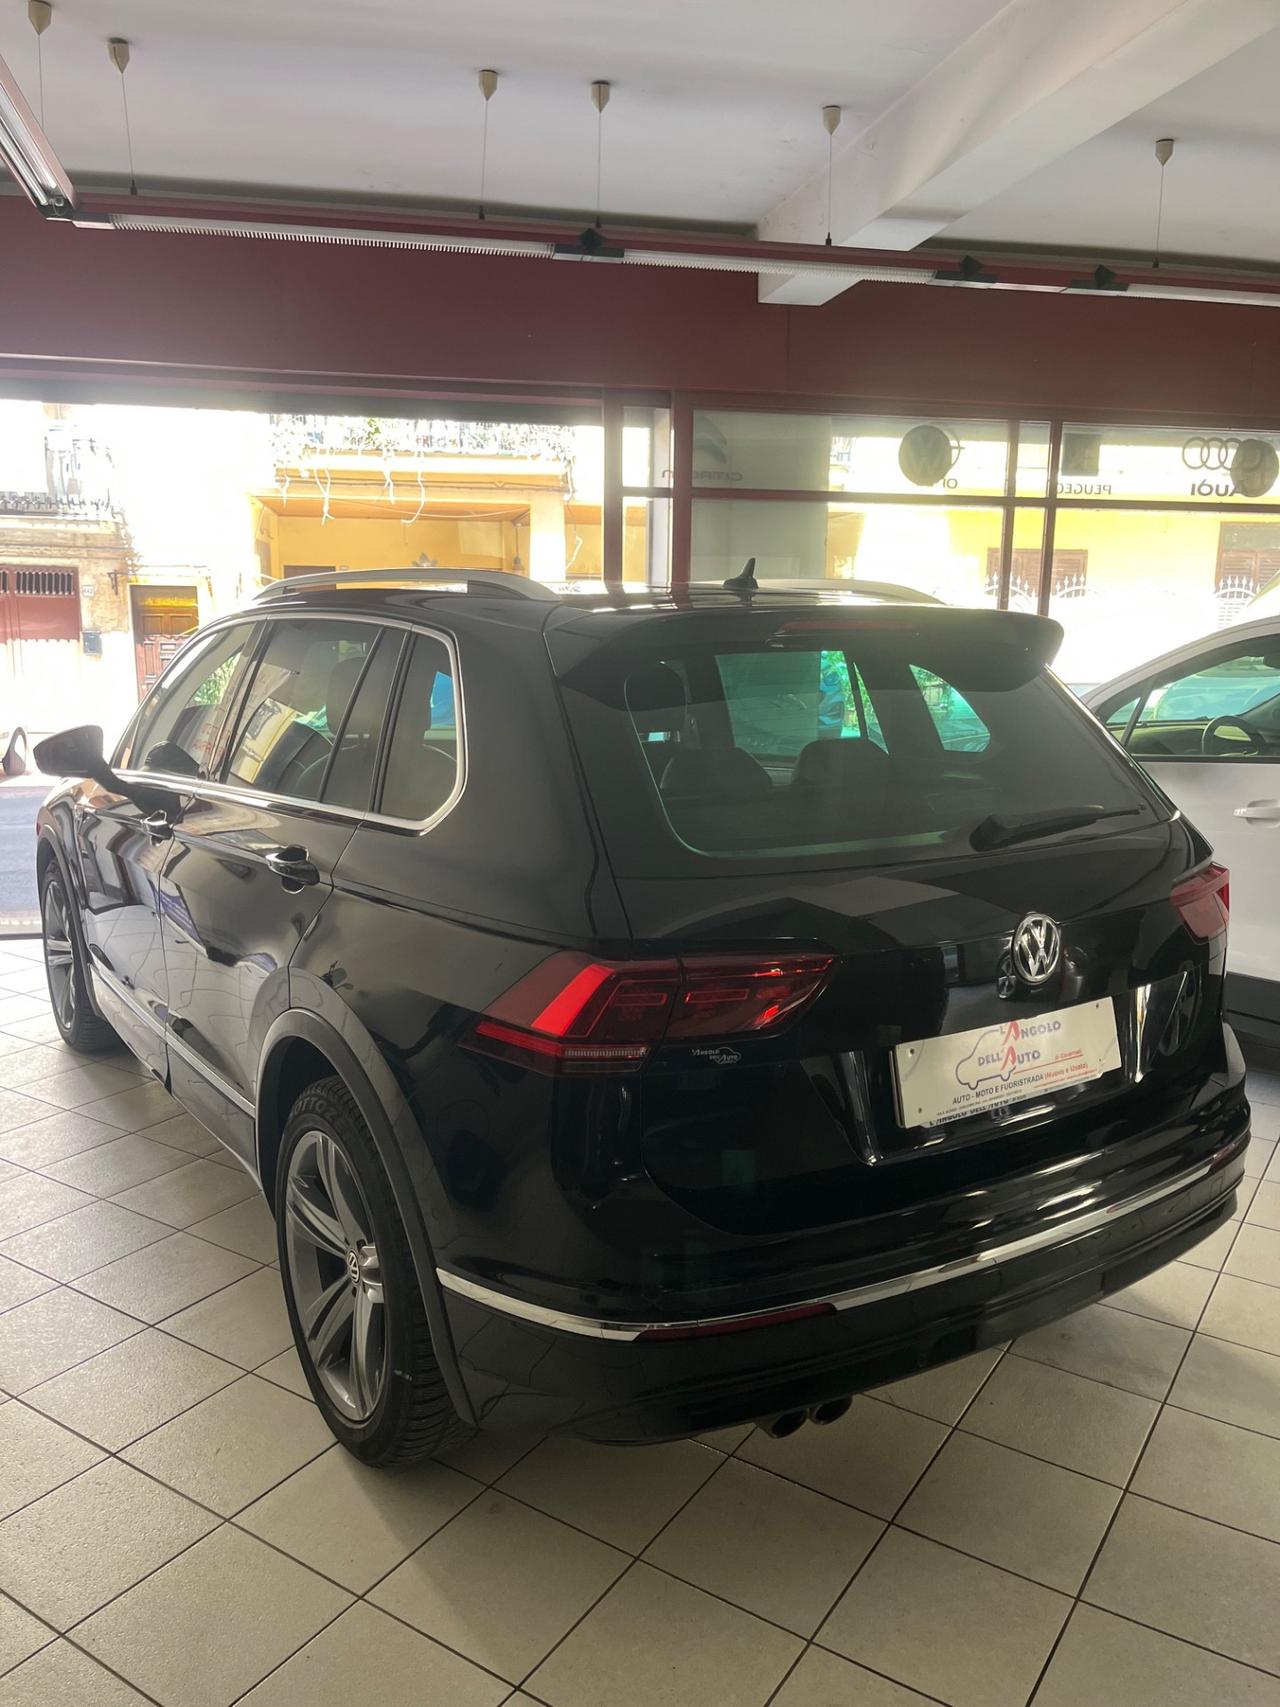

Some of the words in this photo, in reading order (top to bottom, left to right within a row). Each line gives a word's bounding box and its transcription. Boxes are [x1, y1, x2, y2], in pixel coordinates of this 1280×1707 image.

[952, 1093, 971, 1105] AUTO
[975, 1087, 994, 1100] MOTO
[995, 1086, 999, 1094] E
[1000, 1074, 1044, 1092] FUORISTRADA
